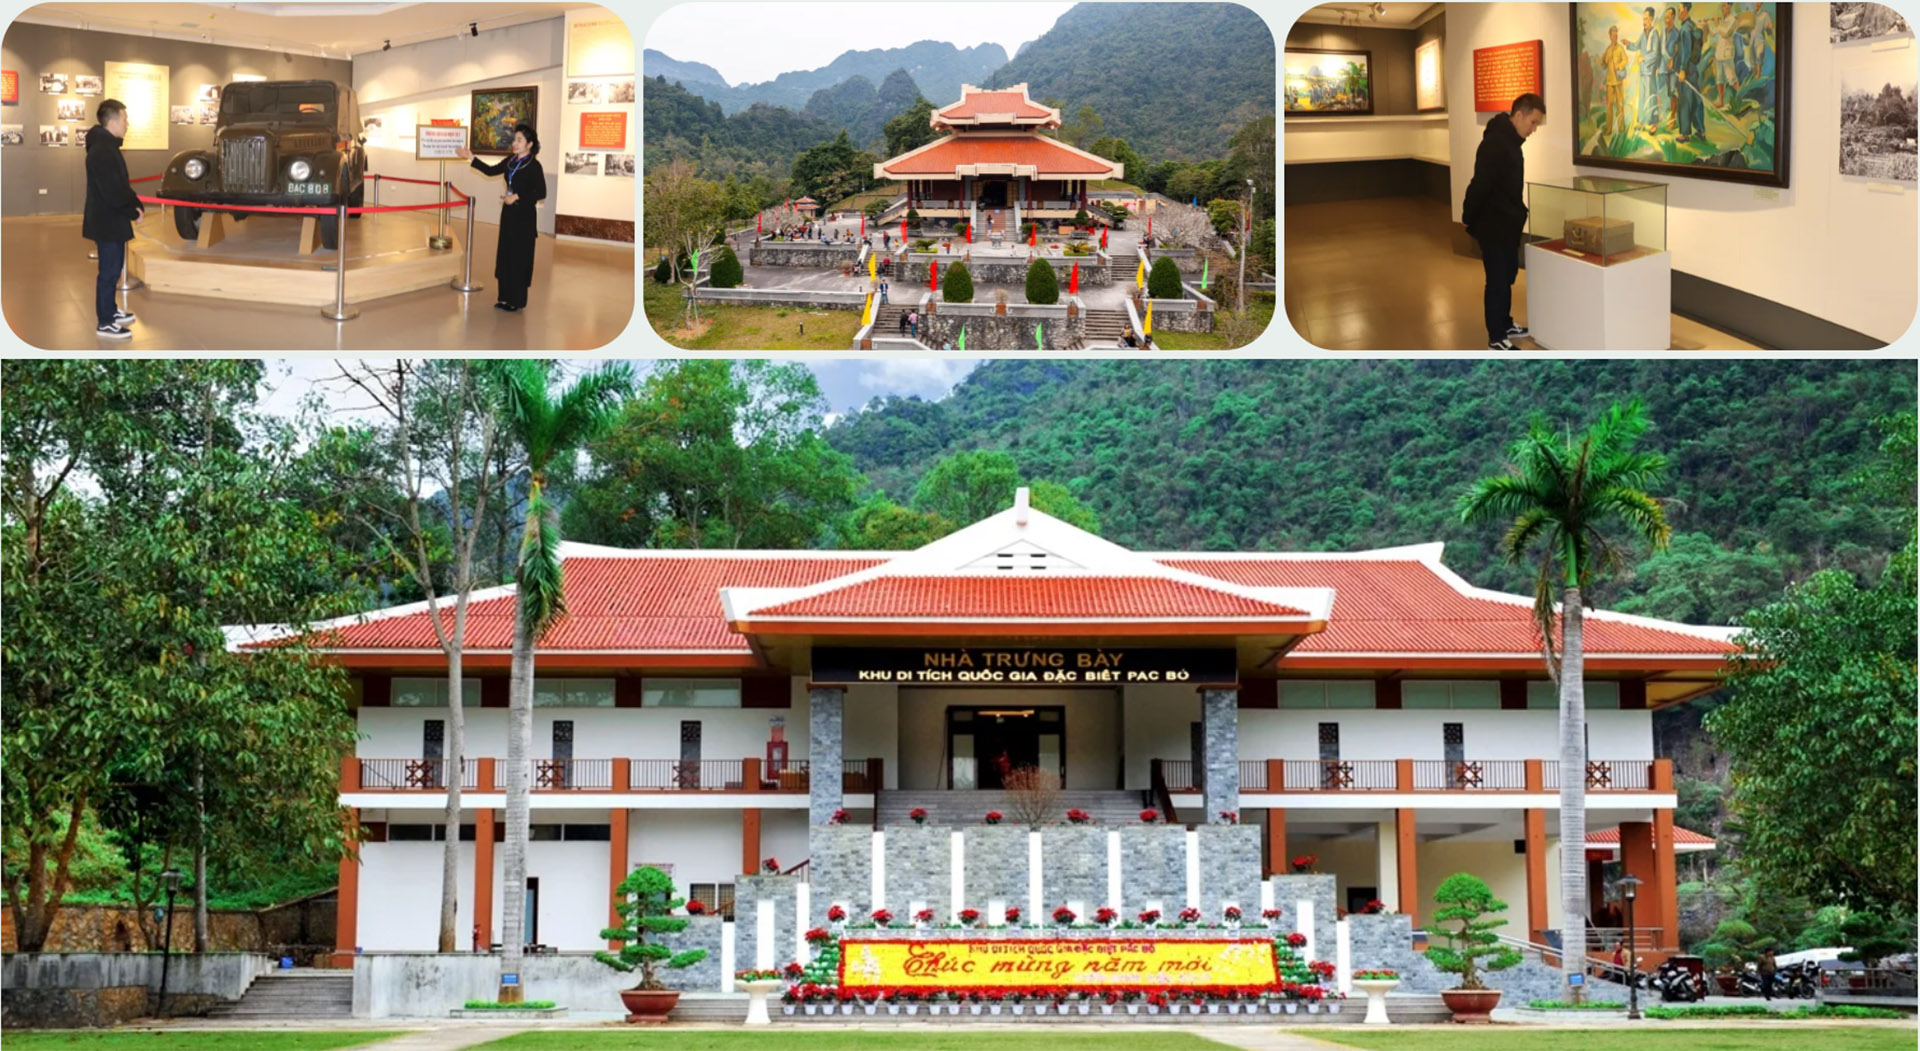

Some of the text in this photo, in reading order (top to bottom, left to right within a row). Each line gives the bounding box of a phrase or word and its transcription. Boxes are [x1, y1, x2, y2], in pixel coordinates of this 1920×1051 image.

[288, 182, 329, 195] BAC 808
[924, 649, 1123, 668] NHÀ TRƯNG BÀY
[859, 670, 892, 681] KHU
[896, 670, 912, 681] DI
[917, 668, 953, 681] TÍCH
[1008, 670, 1038, 681] GIA
[1043, 668, 1077, 684] ĐẶC
[1083, 957, 1147, 972] năm
